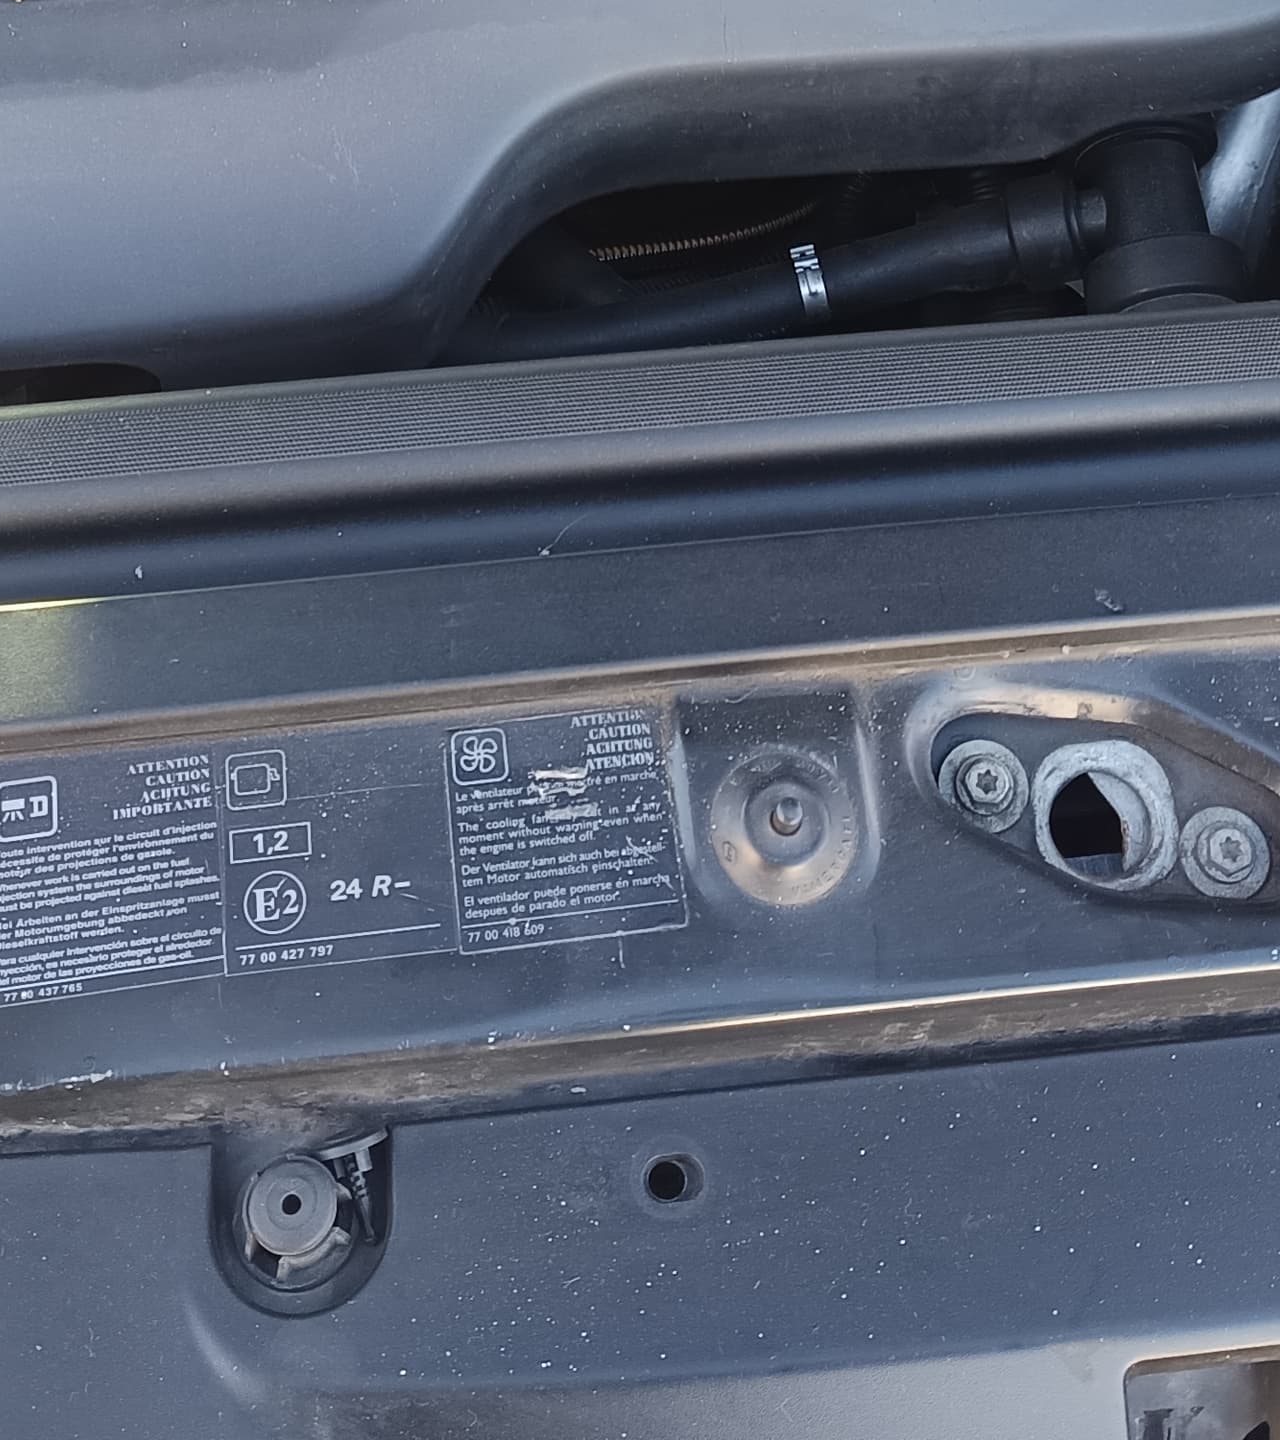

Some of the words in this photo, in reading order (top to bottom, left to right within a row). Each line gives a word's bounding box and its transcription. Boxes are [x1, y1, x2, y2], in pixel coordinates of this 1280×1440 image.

[589, 722, 651, 740] CAUTION
[584, 737, 653, 756] ACHTUNG
[127, 754, 209, 777] ATTENTION
[586, 752, 655, 770] ATENCION
[145, 768, 210, 787] CAUTION
[605, 776, 617, 784] en
[141, 781, 212, 802] ACHTUNG
[456, 792, 467, 801] Le
[112, 795, 214, 821] IMPORTANTE
[456, 803, 484, 815] après
[488, 799, 514, 810] arrêt
[643, 799, 660, 811] any
[457, 823, 479, 832] The
[486, 818, 525, 829] cooling
[459, 832, 504, 844] moment
[508, 825, 551, 838] without
[603, 817, 629, 827] even
[252, 831, 290, 855] 1,2
[460, 846, 476, 856] the
[480, 843, 513, 854] engine
[517, 841, 526, 849] is
[529, 831, 576, 848] switched
[577, 827, 595, 841] off.
[462, 865, 480, 875] Der
[482, 860, 530, 872] Ventilator
[532, 857, 556, 867] kann
[558, 853, 577, 863] sich
[579, 849, 601, 861] auch
[604, 849, 619, 858] bei
[463, 878, 483, 887] tem
[487, 874, 520, 884] Motor
[525, 863, 588, 879] automatisch
[330, 879, 364, 902] 24
[464, 896, 474, 906] El
[478, 891, 530, 904] ventilador
[534, 886, 566, 901] puede
[570, 882, 612, 896] ponerse
[465, 907, 508, 919] despues
[511, 903, 525, 913] de
[529, 897, 566, 913] parado
[570, 894, 580, 905] el
[467, 931, 483, 943] 77
[485, 929, 501, 941] 00
[504, 927, 525, 940] 418
[239, 952, 255, 965] 77
[260, 950, 276, 964] 00
[280, 947, 307, 961] 427
[307, 944, 334, 959] 797
[4, 991, 17, 1003] 77
[37, 986, 58, 999] 437
[61, 982, 83, 996] 765
